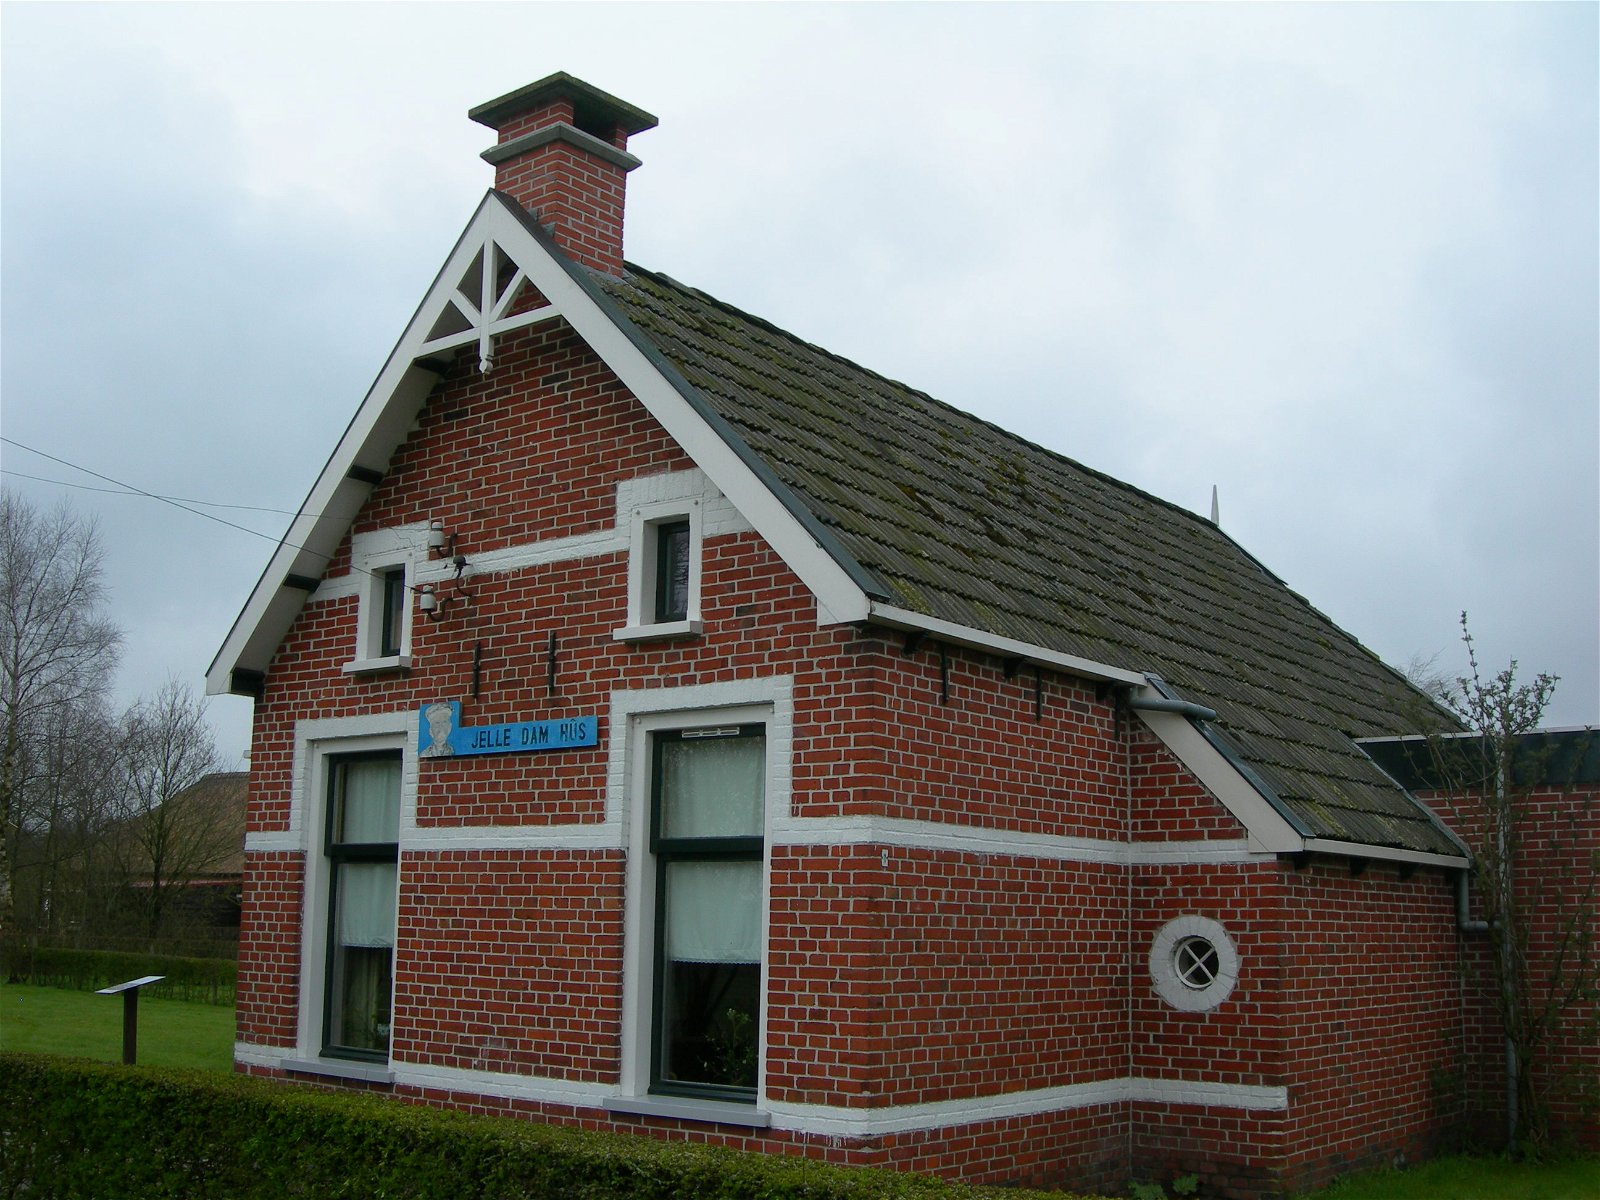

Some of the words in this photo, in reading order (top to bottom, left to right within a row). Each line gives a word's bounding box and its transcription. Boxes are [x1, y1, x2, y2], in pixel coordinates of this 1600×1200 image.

[471, 729, 511, 749] JELLE
[522, 726, 549, 745] DAM
[560, 719, 586, 741] HÛS
